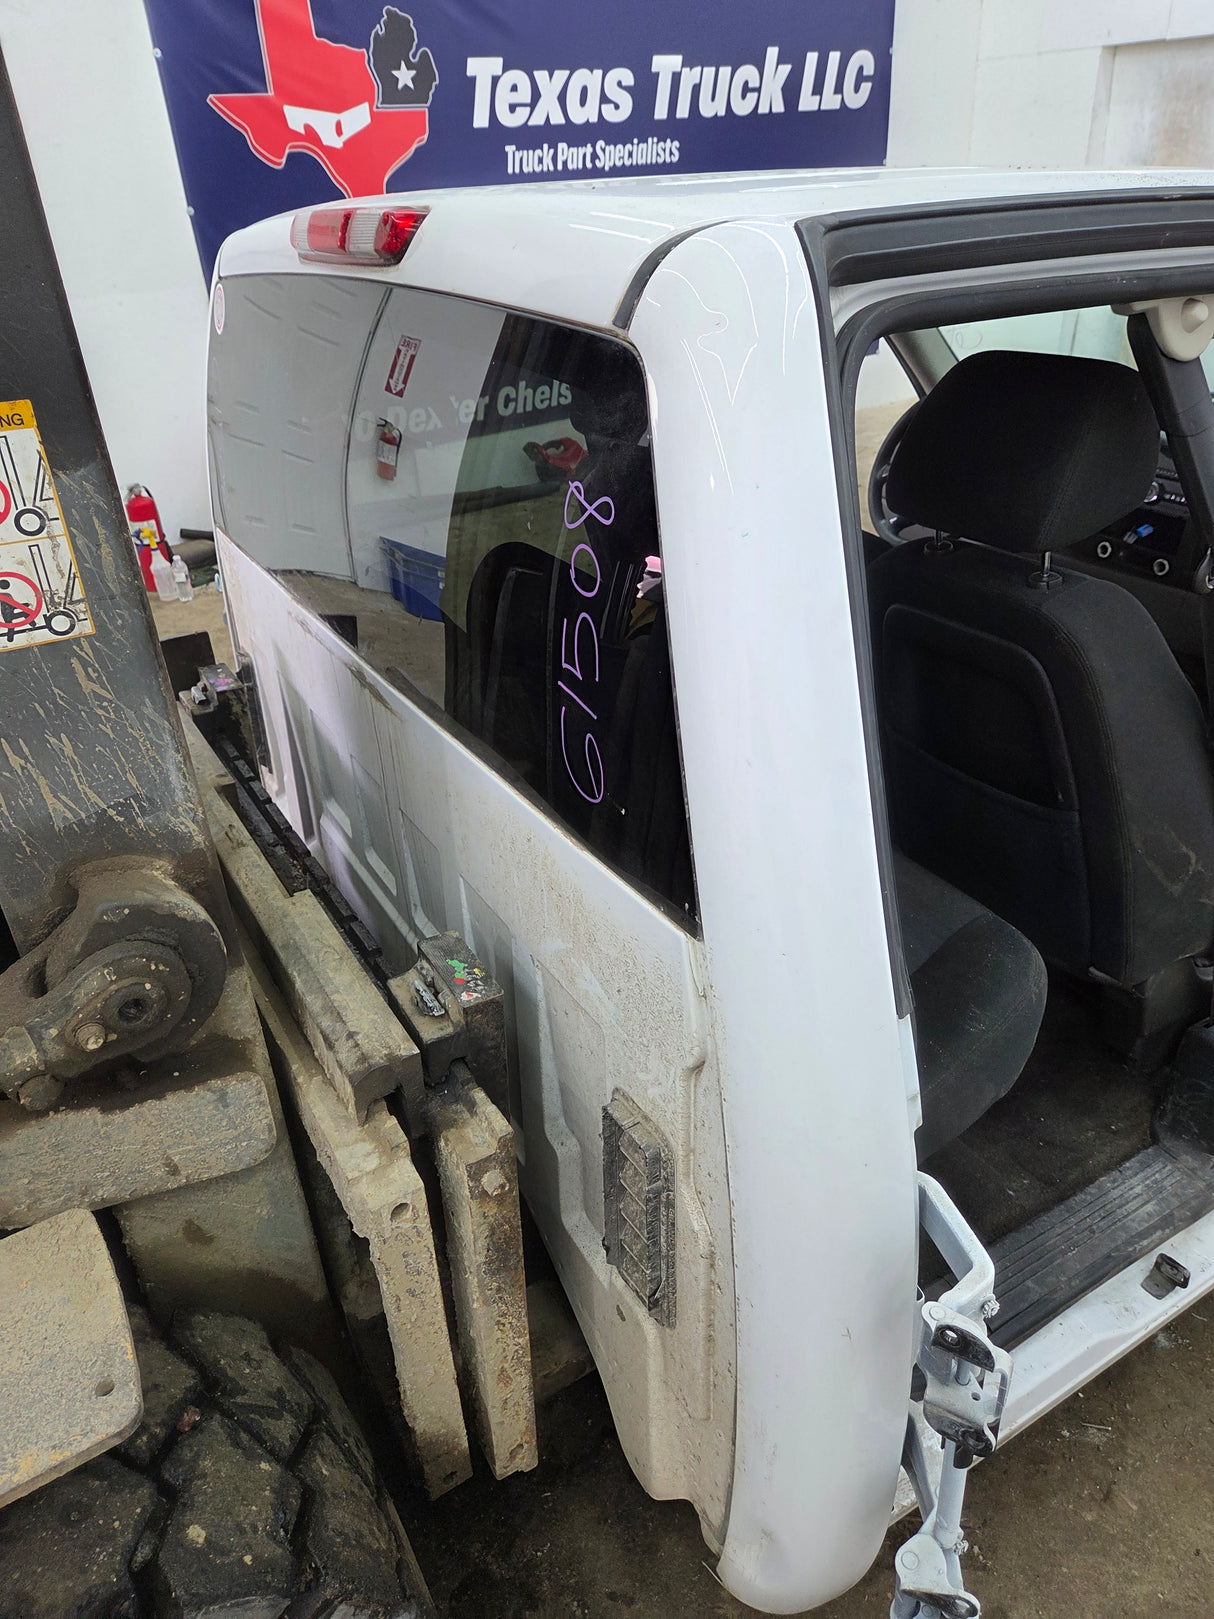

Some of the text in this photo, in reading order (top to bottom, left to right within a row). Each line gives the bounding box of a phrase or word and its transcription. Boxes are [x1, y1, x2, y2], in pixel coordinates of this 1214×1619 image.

[466, 46, 875, 129] Texas Truck LLC
[504, 136, 680, 175] Truck Part Specialists
